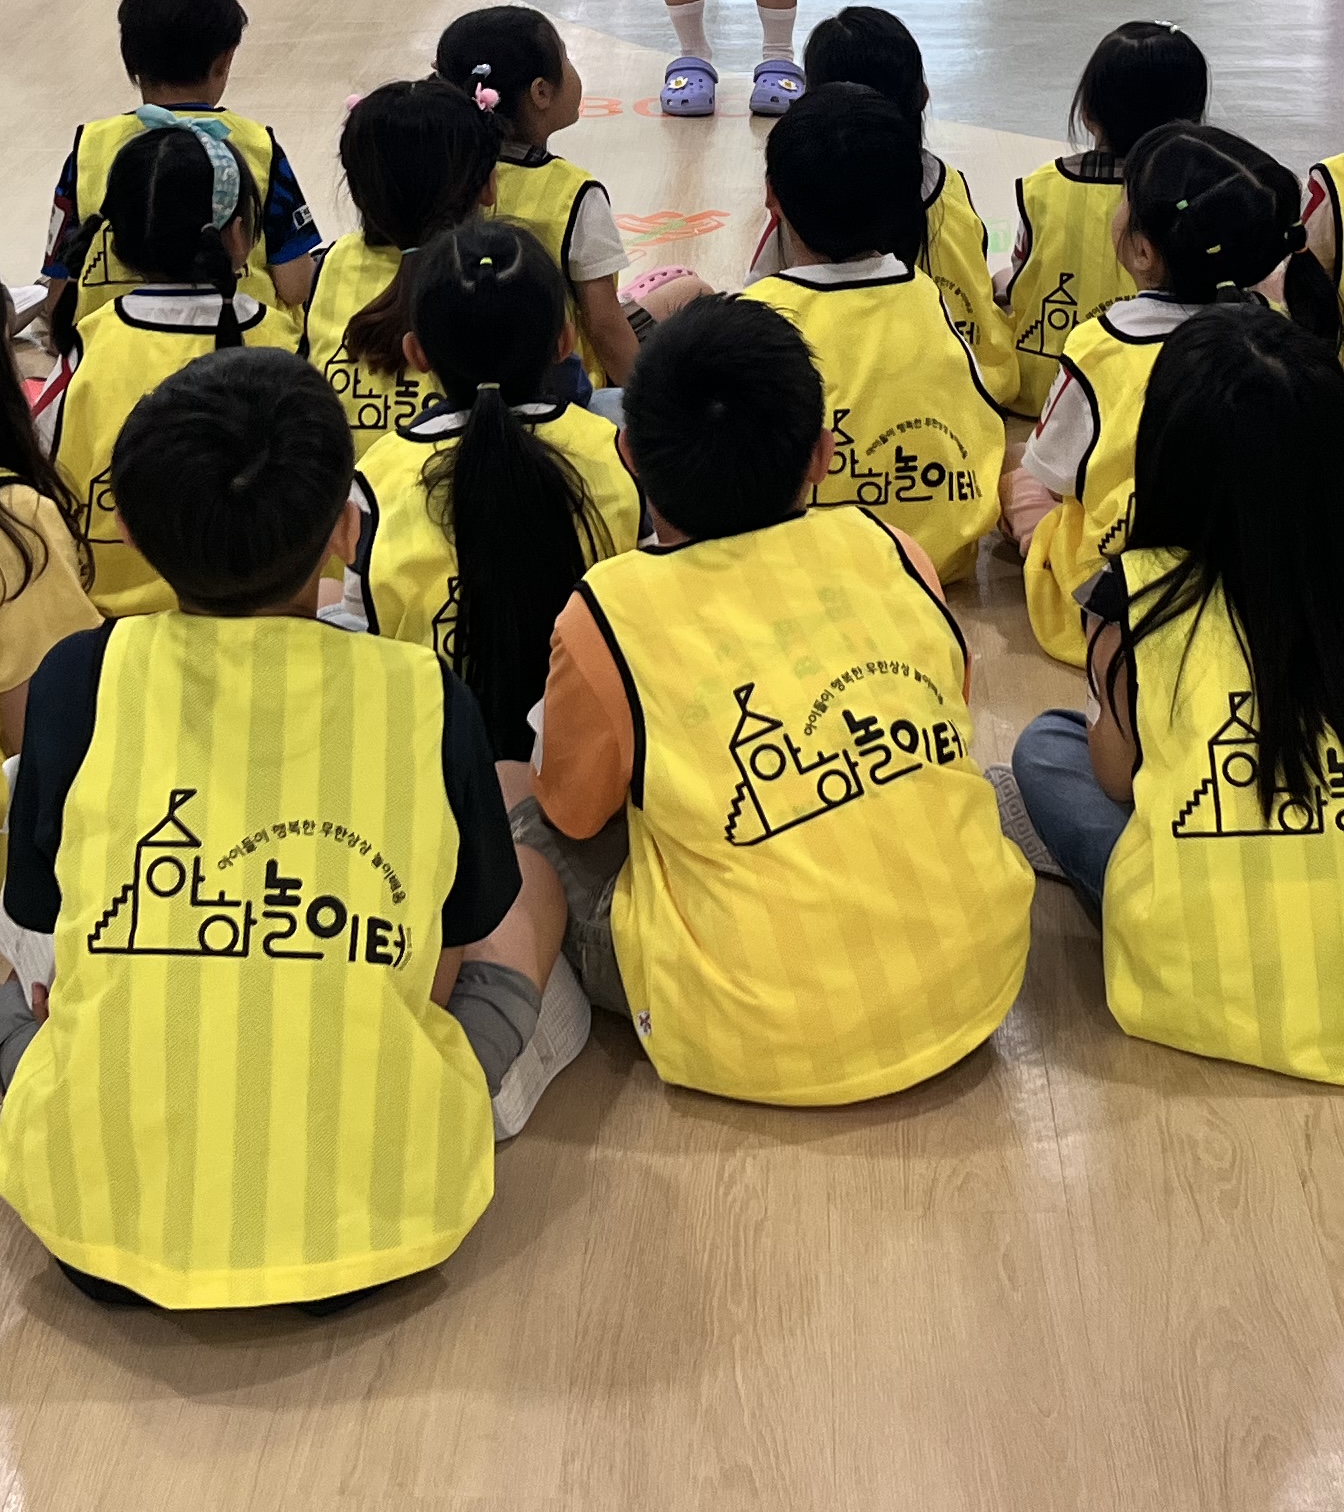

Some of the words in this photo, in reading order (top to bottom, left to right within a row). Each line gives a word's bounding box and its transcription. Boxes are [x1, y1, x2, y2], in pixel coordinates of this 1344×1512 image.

[803, 689, 835, 737] 아이들이
[830, 665, 865, 692] 행복한
[865, 659, 911, 677] 무한상상
[216, 827, 271, 871] 아이들이
[271, 818, 317, 840] 행복한
[320, 820, 374, 857] 무한상상
